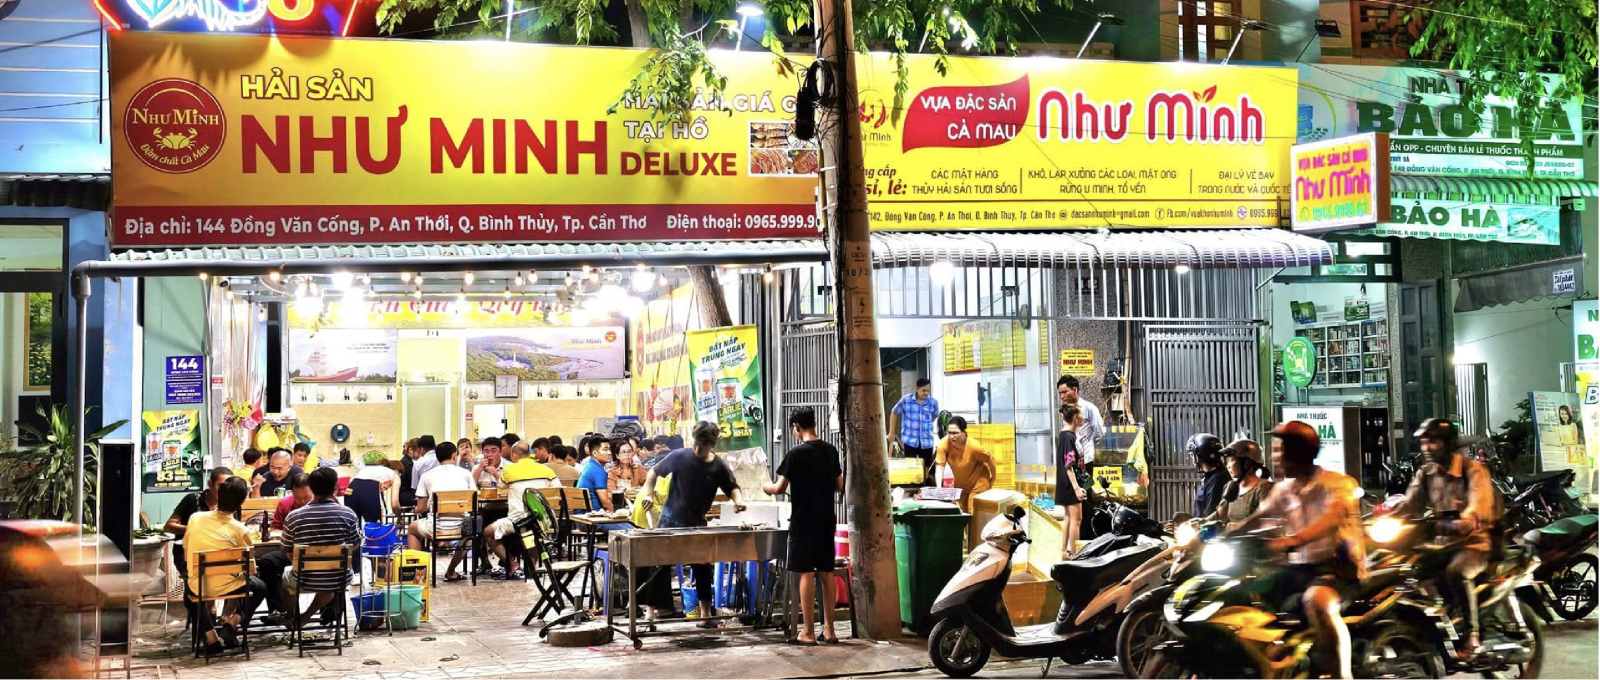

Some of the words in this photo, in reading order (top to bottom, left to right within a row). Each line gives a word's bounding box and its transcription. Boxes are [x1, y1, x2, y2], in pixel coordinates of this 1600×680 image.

[240, 66, 300, 100] HẢI
[306, 68, 374, 101] SẢN
[732, 91, 775, 113] GIÁ
[920, 95, 950, 113] VỰA
[955, 93, 984, 113] ĐẶC
[241, 105, 409, 174] NHƯ
[430, 117, 608, 175] MINH
[947, 119, 970, 140] CÀ
[1425, 144, 1456, 153] CHUYÊN
[620, 151, 738, 176] DELUXE
[877, 163, 897, 179] cấp
[125, 217, 154, 238] Địa
[160, 215, 191, 234] chỉ:
[196, 218, 225, 234] 144
[230, 215, 275, 237] Đồng
[280, 216, 312, 233] Văn
[317, 214, 364, 236] Cống,
[369, 217, 384, 232] P.
[388, 217, 411, 231] An
[415, 216, 454, 234] Thới,
[458, 216, 474, 233] Q.
[479, 215, 513, 231] Bình
[518, 213, 558, 233] Thủy,
[562, 216, 584, 233] Tp.
[588, 213, 616, 230] Cần
[620, 215, 646, 229] Thơ
[667, 214, 698, 232] Điện
[702, 214, 741, 232] thoại:
[1390, 200, 1450, 227] BẢO
[1461, 205, 1502, 229] HÀ
[171, 358, 199, 370] 144
